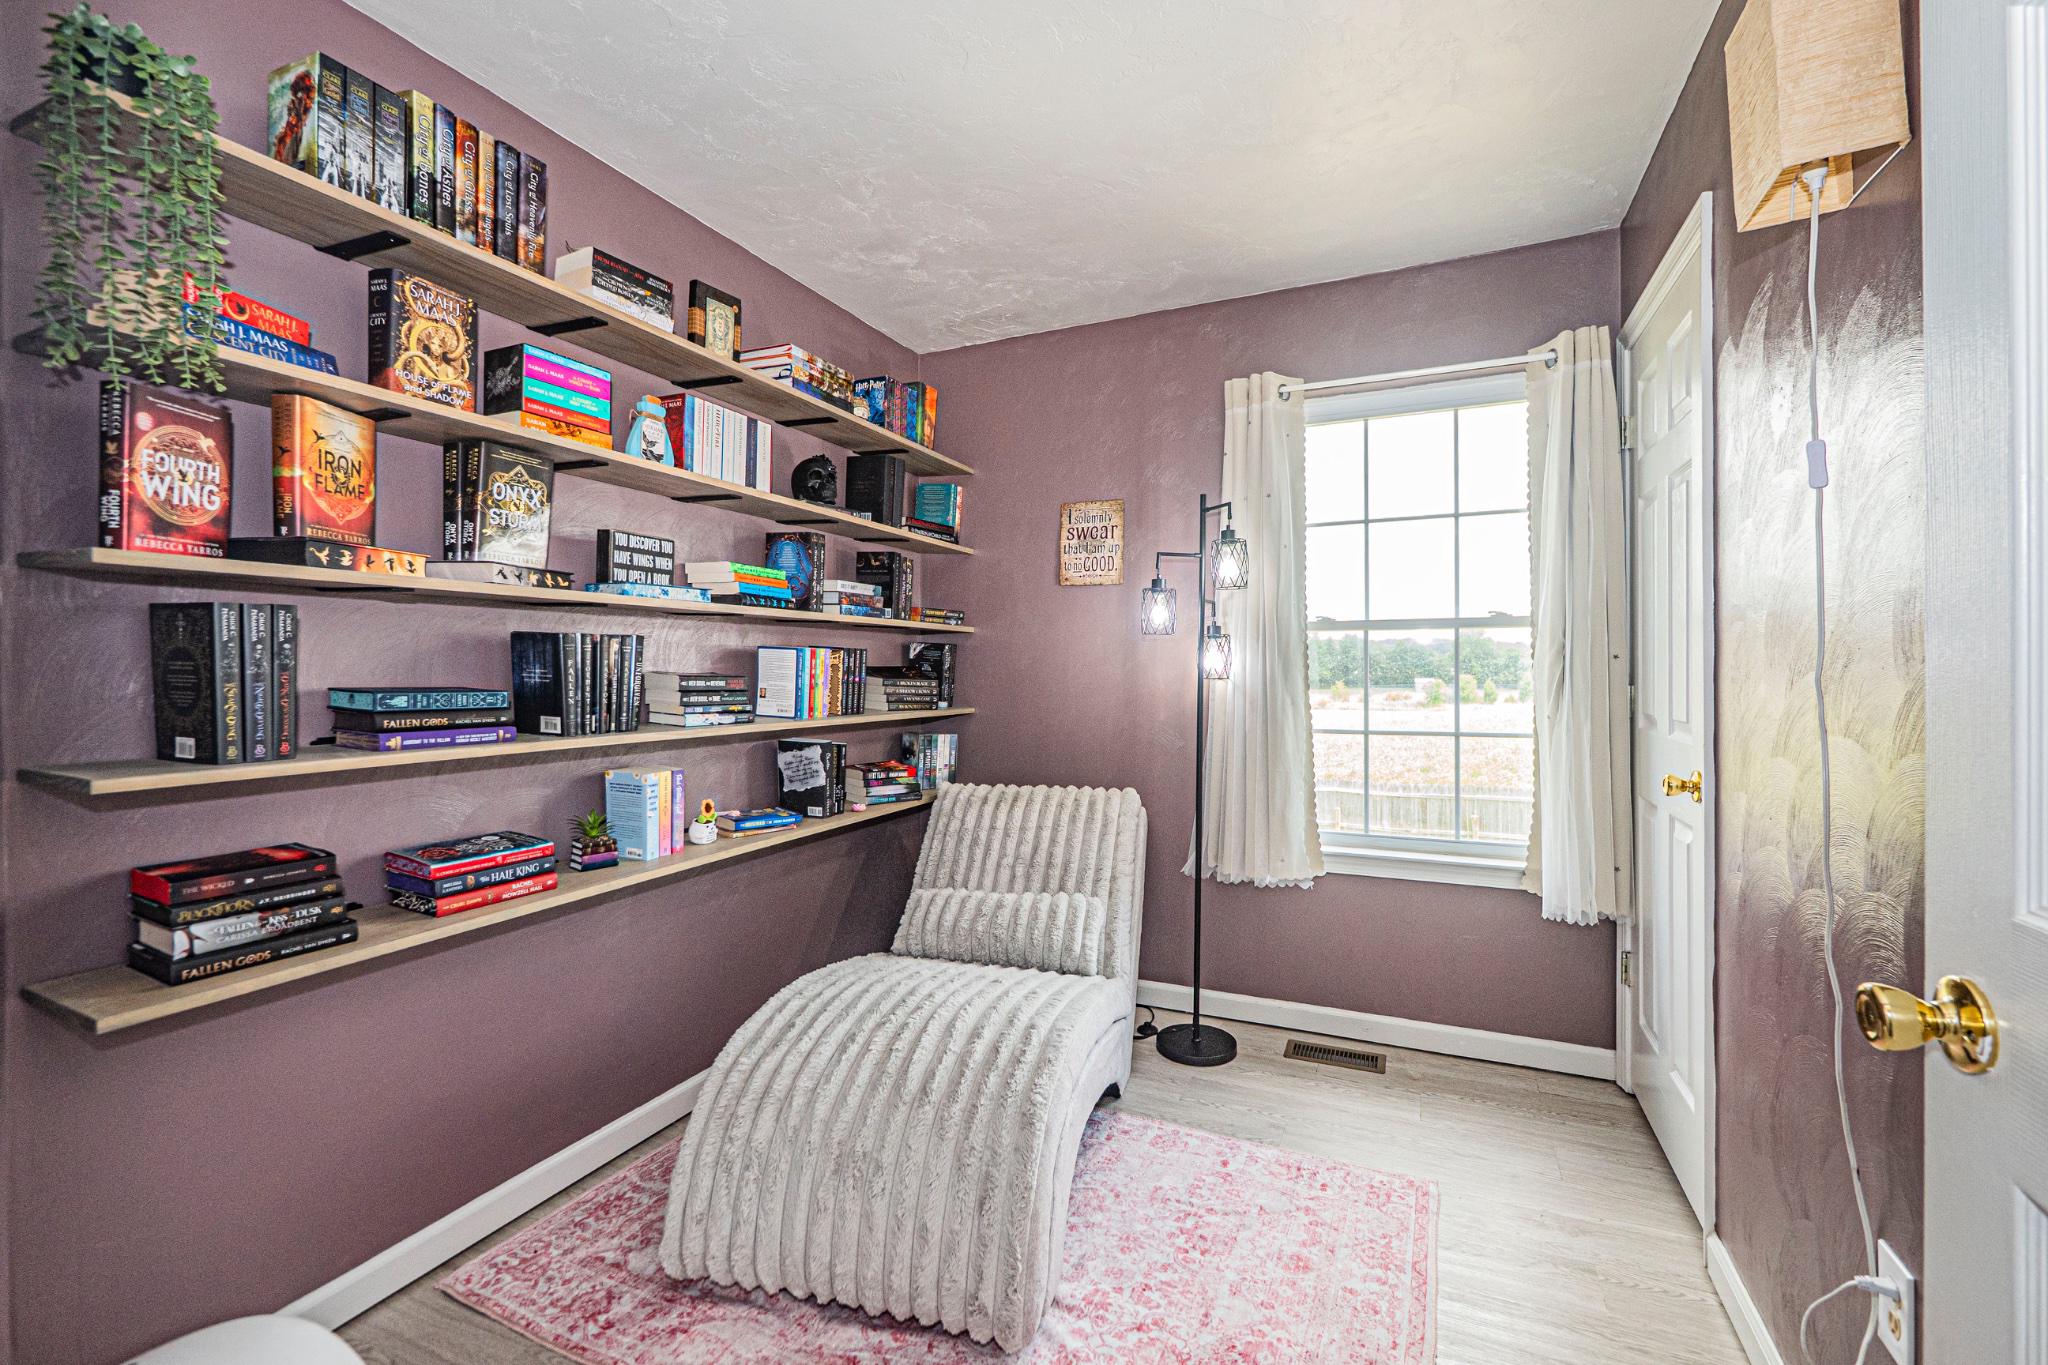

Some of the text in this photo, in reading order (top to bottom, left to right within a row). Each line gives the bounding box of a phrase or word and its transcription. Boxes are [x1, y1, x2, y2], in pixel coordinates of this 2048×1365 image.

[442, 129, 454, 156] City
[464, 141, 476, 166] City
[417, 115, 431, 204] City of Bones
[504, 160, 514, 180] City
[442, 168, 454, 207] Ashes
[528, 172, 539, 191] City
[464, 180, 475, 213] Glass
[505, 190, 514, 210] Lost
[504, 211, 514, 236] Souls
[528, 201, 538, 239] Heavenly
[529, 241, 538, 258] Fire
[410, 284, 453, 310] SARAH
[252, 304, 290, 328] SARAH
[370, 318, 386, 326] CITY
[416, 302, 457, 327] MAAS
[250, 330, 288, 352] MAAS
[257, 320, 293, 340] MAAS
[259, 346, 287, 363] CITY
[395, 368, 429, 386] HOUSE
[442, 382, 472, 400] FLAME
[855, 380, 886, 392] Harry Potter
[425, 388, 465, 406] SHADOW
[112, 391, 122, 436] REBECCA
[140, 448, 221, 485] FOURTH
[318, 448, 362, 479] IRON
[140, 470, 221, 512] WING
[314, 473, 366, 500] FLAME
[492, 482, 542, 509] ONYX
[108, 489, 121, 529] FOURTH
[283, 493, 292, 514] IRON
[1068, 508, 1113, 525] I solemnly
[306, 527, 343, 542] REBECCA
[614, 532, 673, 554] YOU DISCOVER YOU
[1066, 524, 1118, 541] swear
[134, 536, 224, 558] REBECCA YARROS
[1064, 542, 1082, 554] that
[1091, 544, 1106, 554] am
[1108, 543, 1120, 556] up
[613, 550, 673, 571] HAVE WINGS WHEN
[1064, 561, 1072, 572] to
[1073, 562, 1083, 572] no
[613, 568, 670, 586] YOU OPEN A BOOK
[568, 659, 576, 704] FALLEN
[633, 662, 643, 706] UNFORGIVEN
[383, 719, 420, 729] FALLEN
[422, 718, 449, 727] GODS
[491, 870, 515, 882] HALF
[516, 863, 540, 876] KING
[260, 916, 318, 935] BROADBENT
[181, 960, 234, 980] FALLEN
[234, 950, 272, 968] GODS
